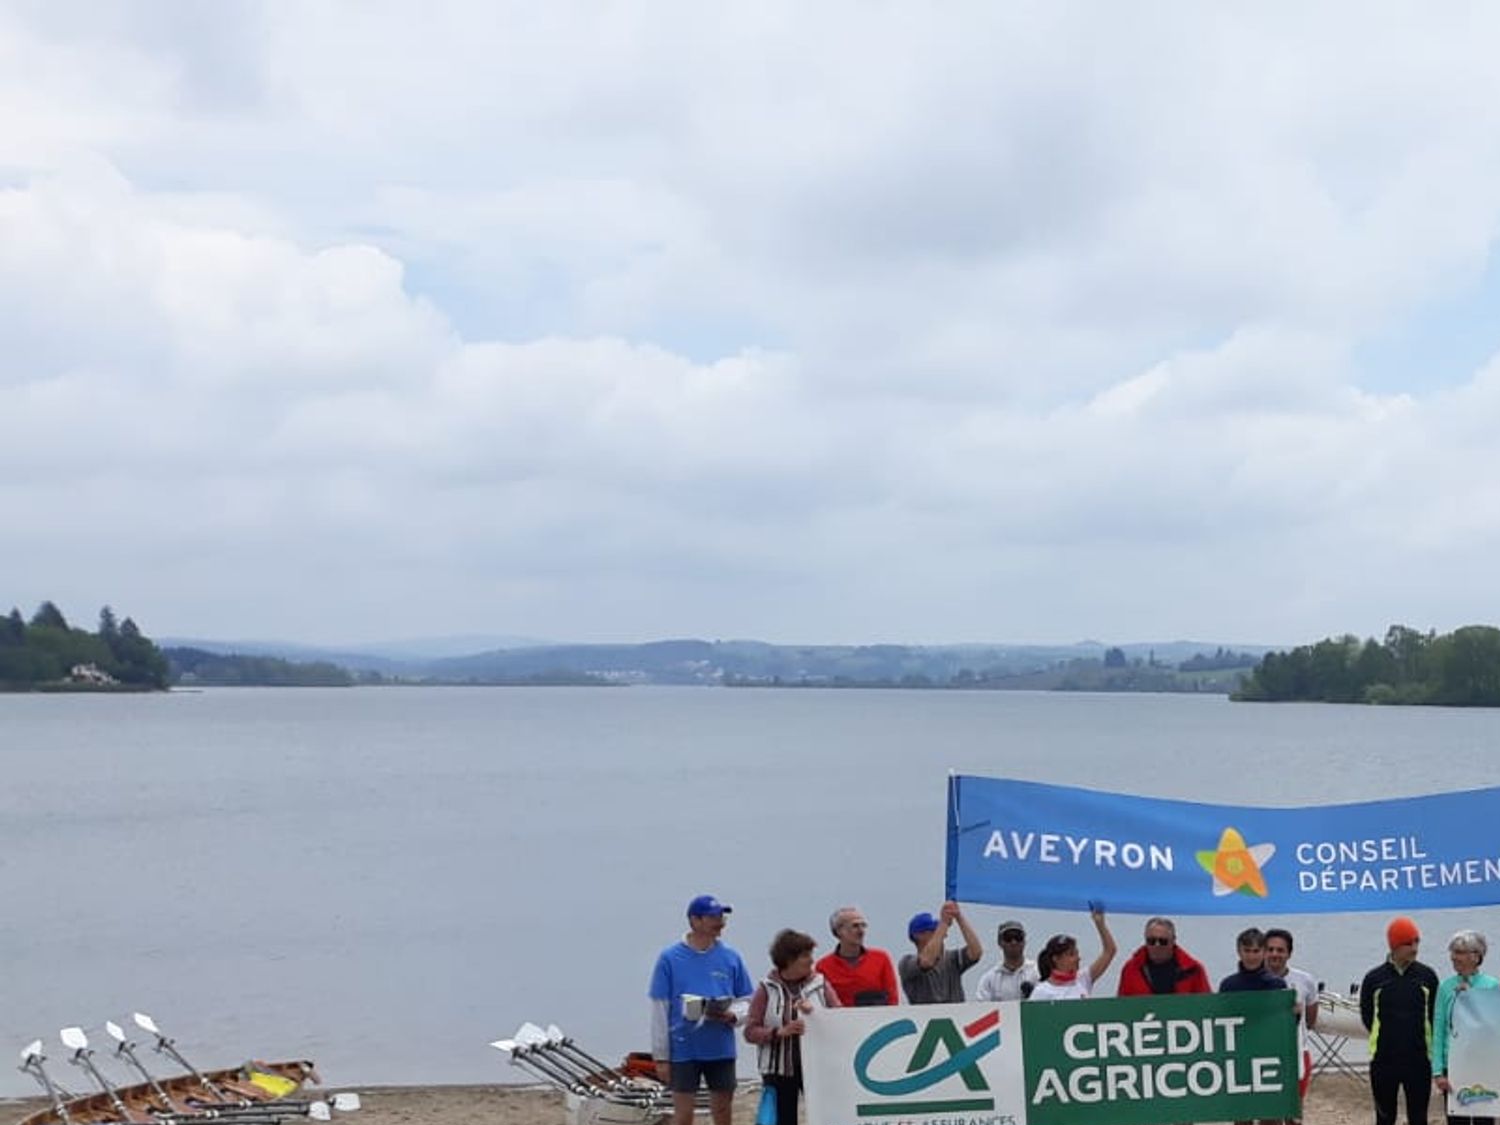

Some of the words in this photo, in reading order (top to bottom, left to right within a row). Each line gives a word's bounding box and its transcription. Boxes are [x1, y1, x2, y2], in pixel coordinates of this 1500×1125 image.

[983, 829, 1174, 872] AVEYRON
[1296, 836, 1427, 865] CONSEIL
[1062, 1012, 1246, 1060] CRÉDIT
[1032, 1057, 1284, 1105] AGRICOLE
